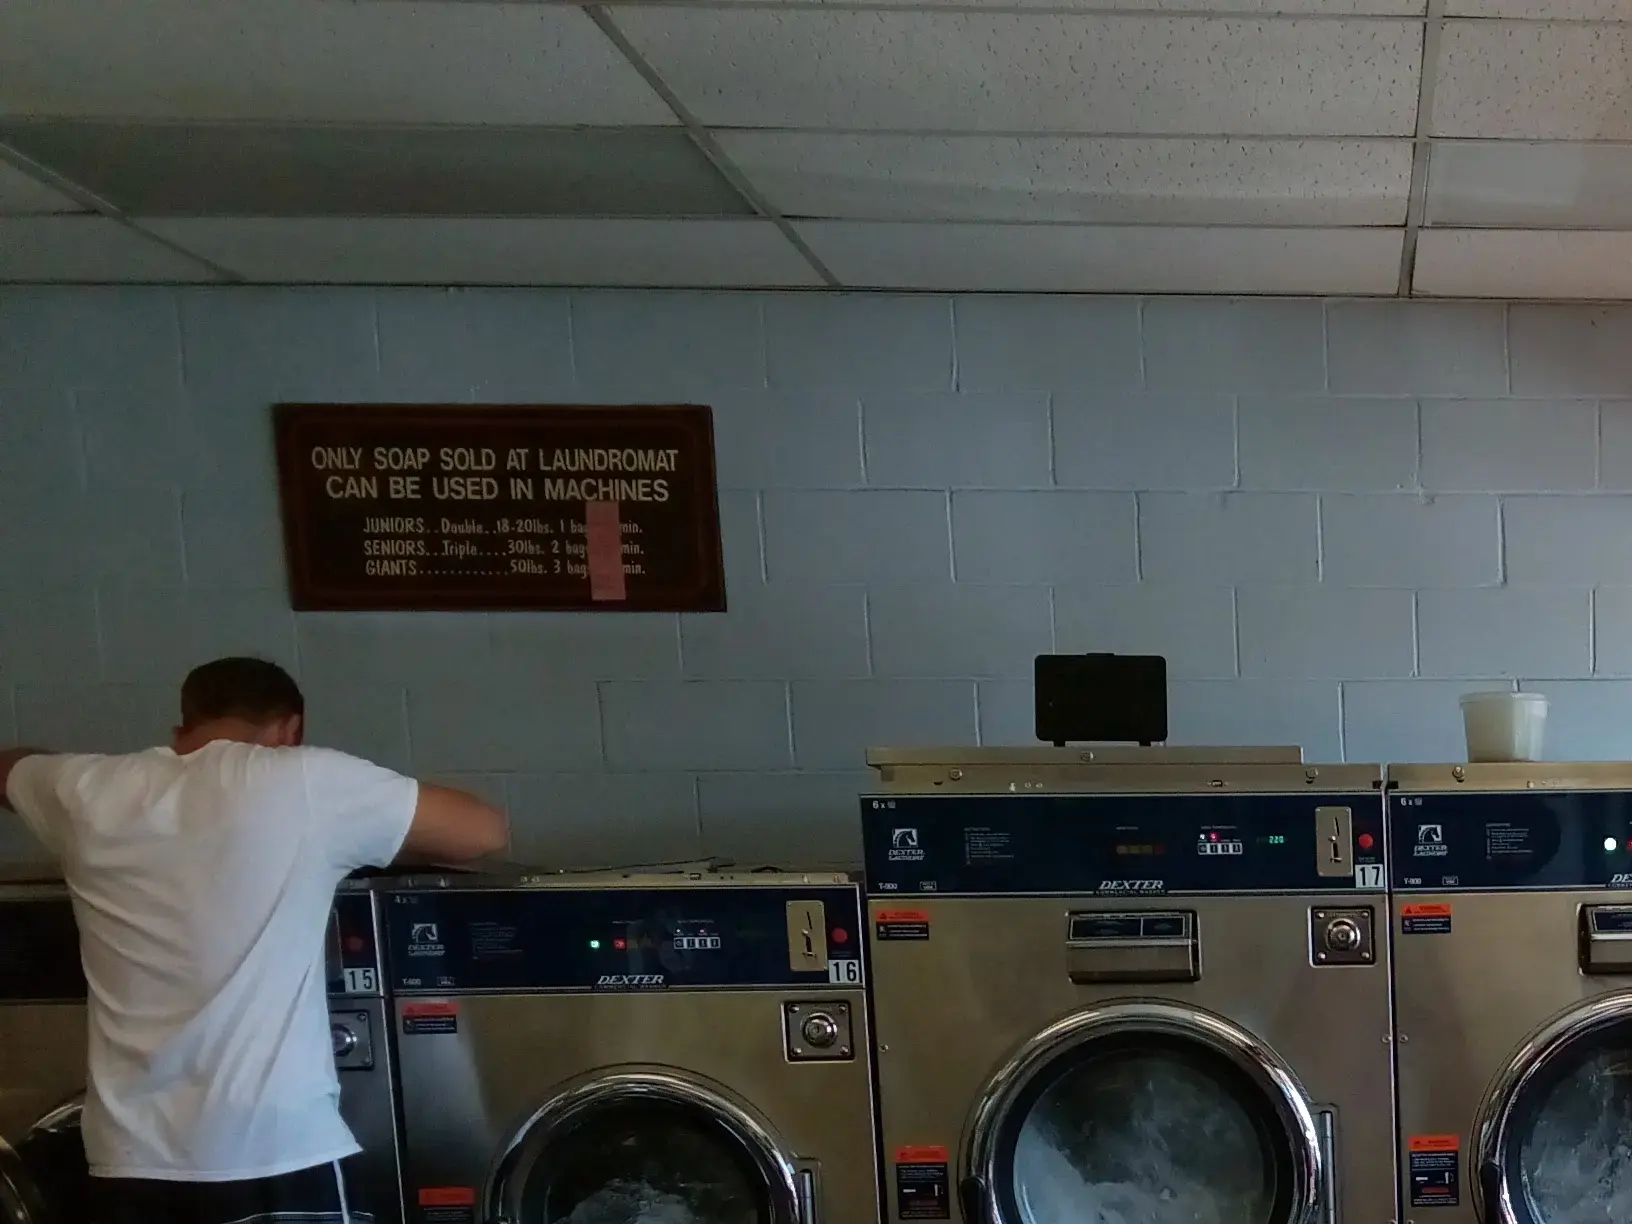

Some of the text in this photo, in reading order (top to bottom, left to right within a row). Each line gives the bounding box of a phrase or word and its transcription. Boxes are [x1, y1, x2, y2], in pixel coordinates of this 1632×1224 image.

[311, 446, 679, 472] ONLY SOAP SOLD AT LAUNDROMAT
[326, 476, 669, 501] CAN BE USED IN MACHINES
[362, 518, 424, 534] JUNIORS
[363, 540, 426, 556] SENIORS
[552, 541, 560, 555] 2
[366, 559, 417, 576] GIANTS
[553, 560, 561, 574] 3
[1099, 880, 1164, 889] DEXTER
[1359, 867, 1382, 886] 17
[348, 970, 372, 990] 15
[598, 975, 664, 984] DEXTER
[832, 962, 856, 982] 16
